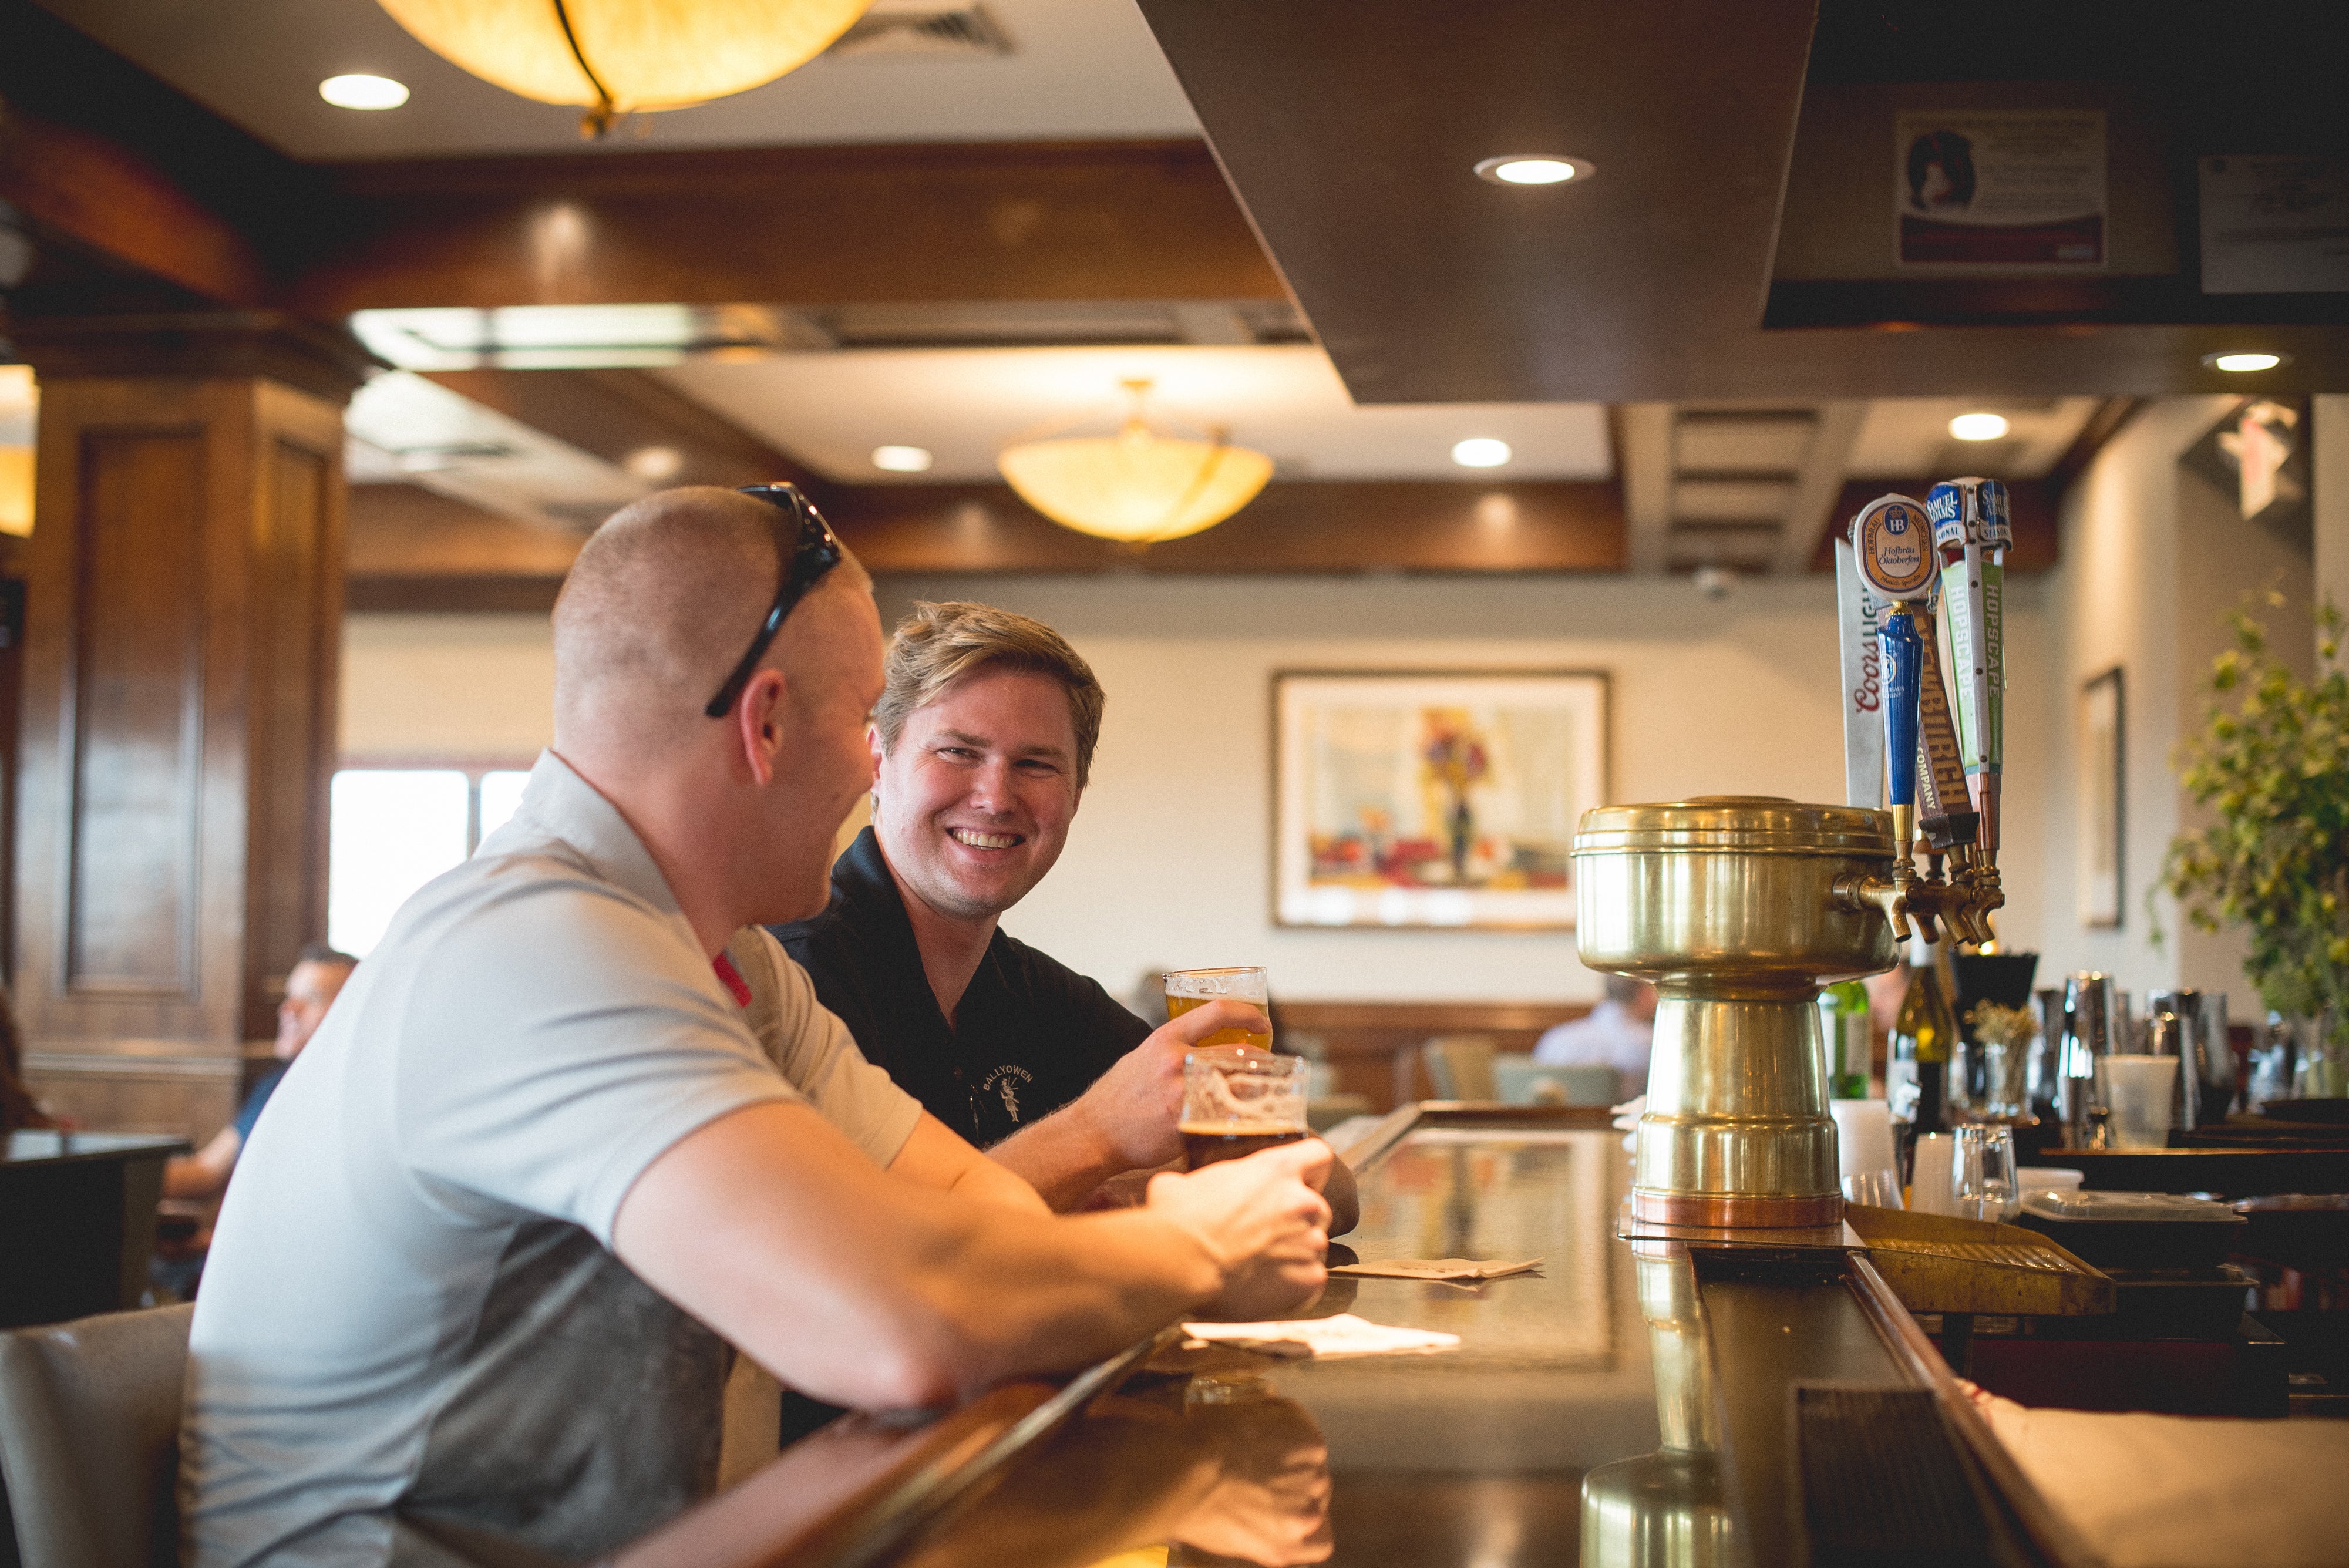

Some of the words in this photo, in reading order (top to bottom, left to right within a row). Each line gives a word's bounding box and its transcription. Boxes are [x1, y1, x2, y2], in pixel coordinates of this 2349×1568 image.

[1926, 491, 1958, 514] SAMUEL
[1889, 519, 1904, 531] HB
[1879, 555, 1920, 565] Oktoberfest
[1882, 546, 1915, 557] Hofbräu
[1880, 575, 1900, 586] Munich
[1951, 585, 1973, 703] HOPSCAPE
[1987, 584, 2000, 698] HOPSCAPE
[1854, 641, 1879, 712] Coors
[1917, 747, 1936, 809] COMPANY
[983, 1065, 1033, 1091] BALLYOWEN
